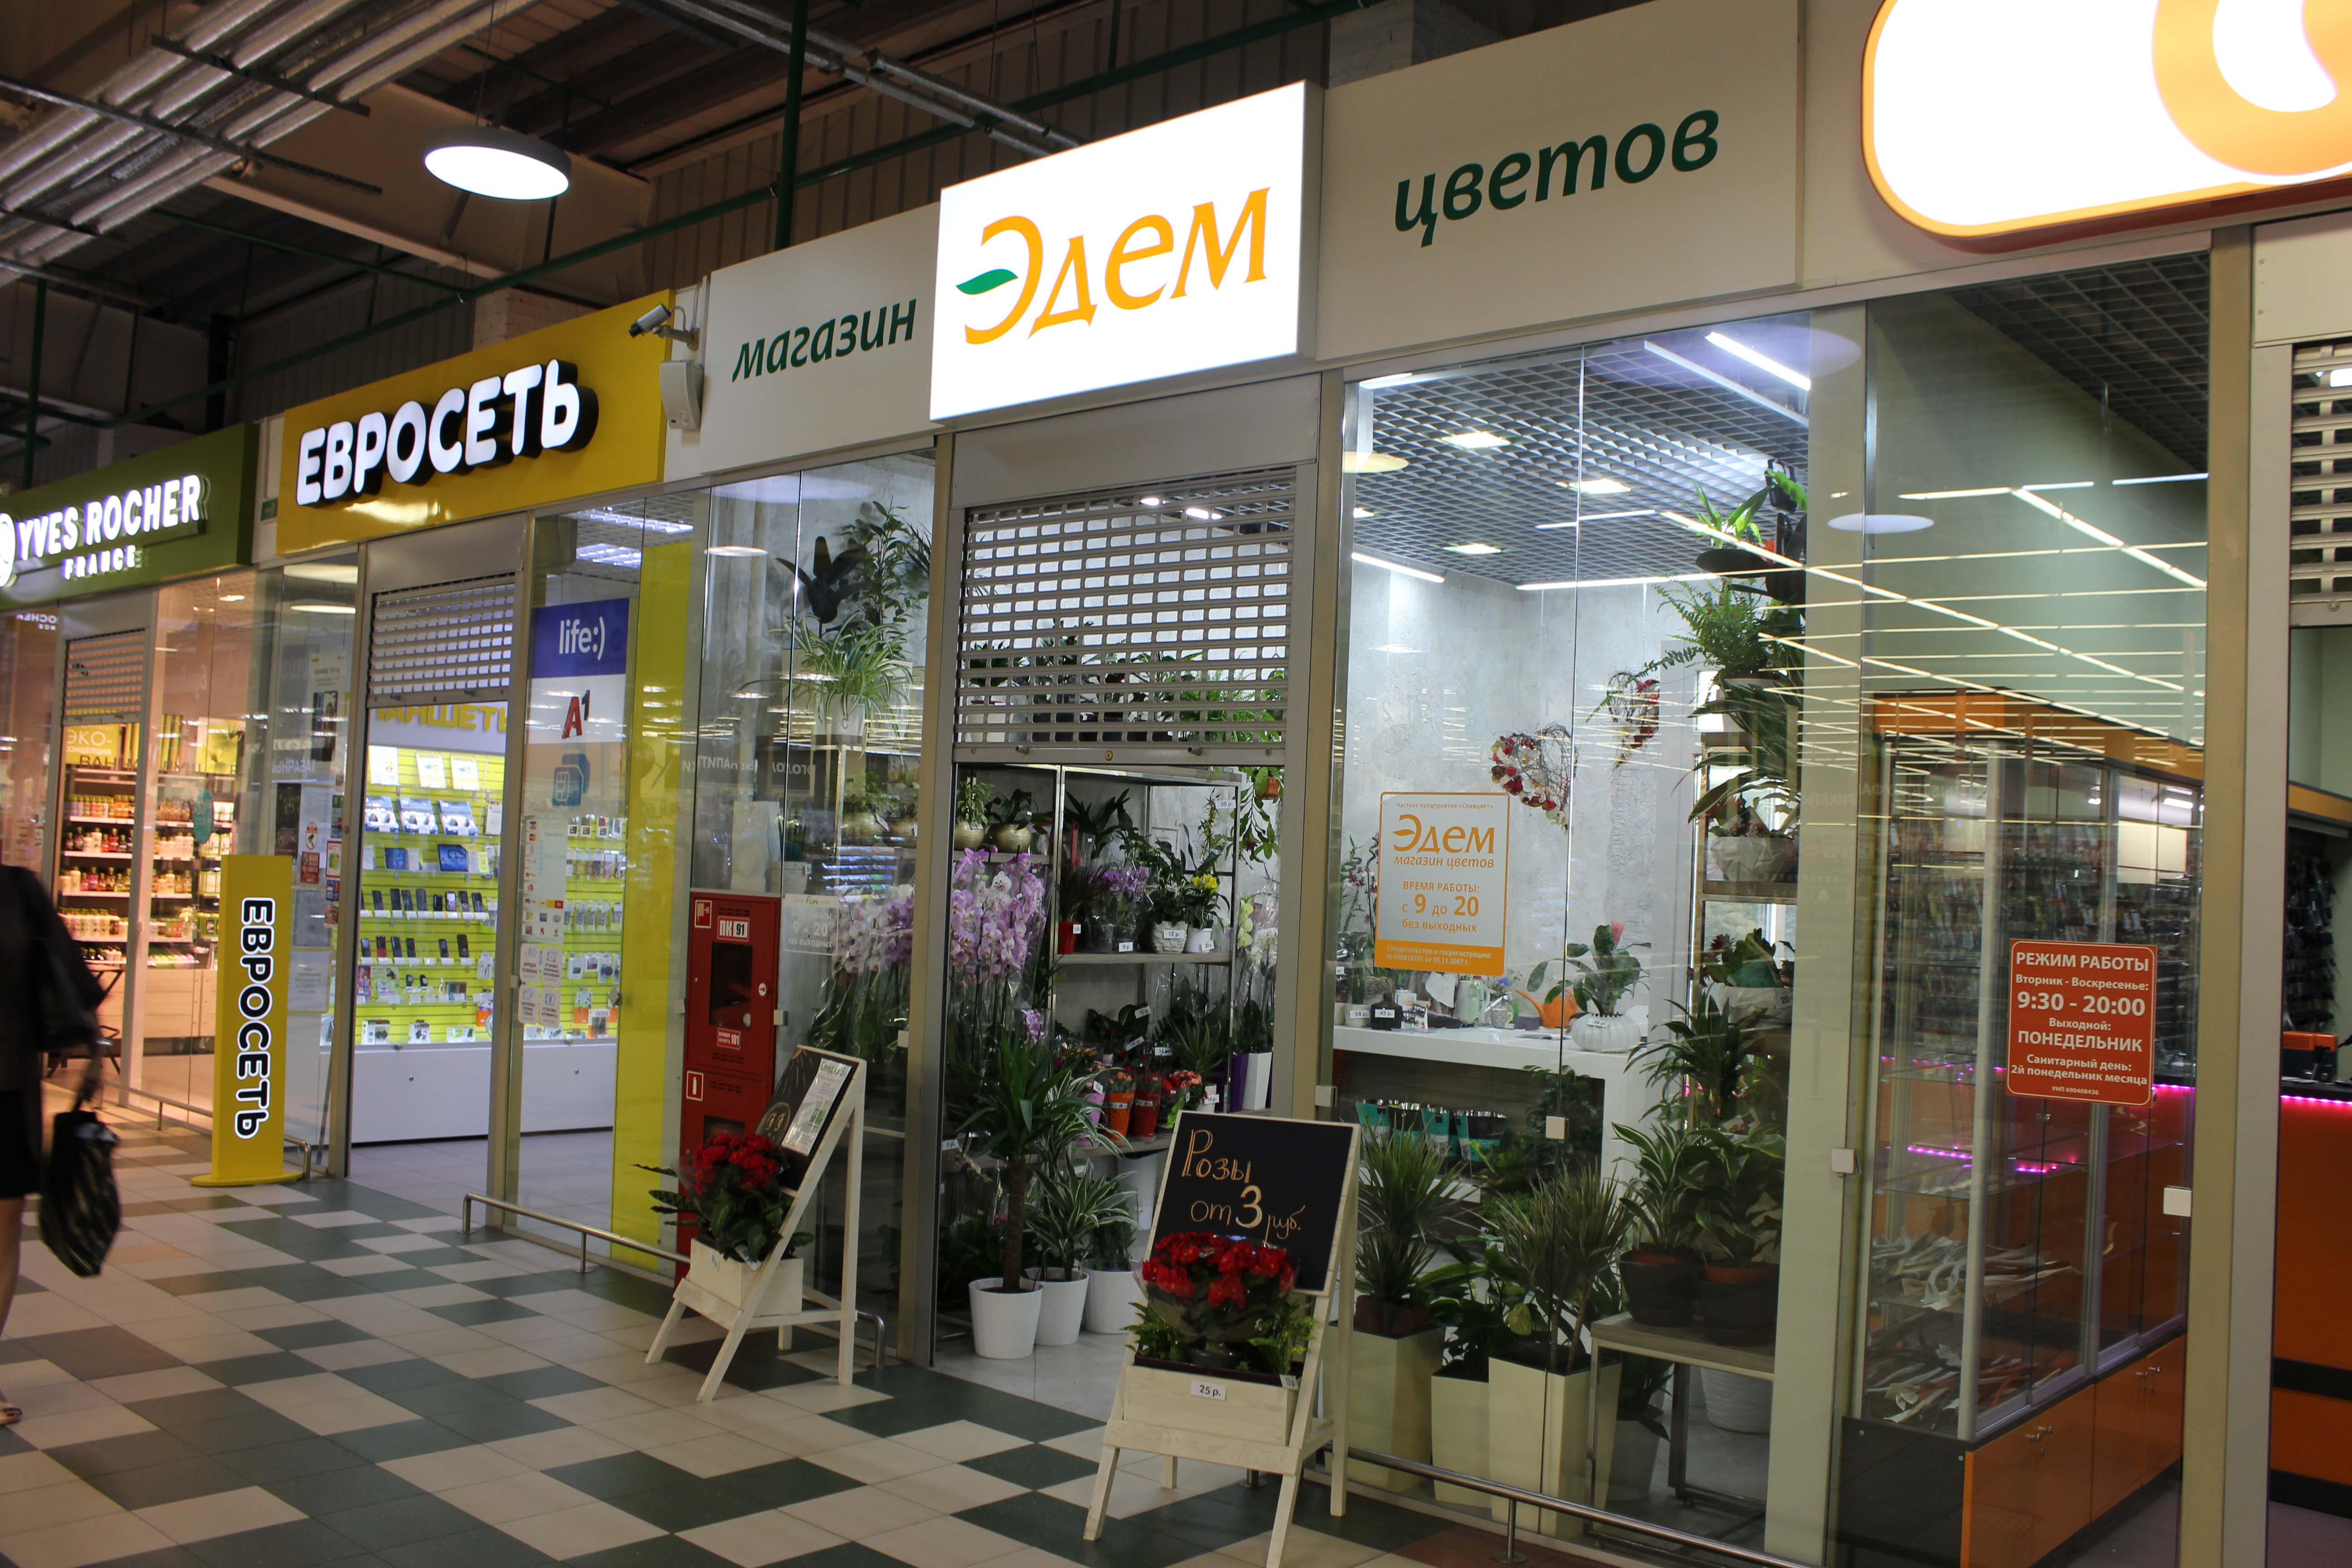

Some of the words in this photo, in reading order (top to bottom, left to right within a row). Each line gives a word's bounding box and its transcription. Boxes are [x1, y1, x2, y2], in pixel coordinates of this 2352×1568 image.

[1395, 109, 1719, 248] цветов
[955, 187, 1270, 344] Эдем
[731, 299, 916, 383] магазин
[296, 359, 581, 506] ЕВРОСЕТЬ
[16, 506, 79, 561] YVES
[85, 475, 201, 545] ROCHER
[63, 545, 136, 580] FRANCE
[559, 616, 606, 661] life:)
[1393, 814, 1495, 854] Эдем
[1394, 856, 1443, 866] магазин
[1447, 857, 1494, 870] цветов
[1403, 881, 1434, 891] ВРЕМЯ
[1437, 883, 1480, 893] РАБОТЫ:
[1415, 894, 1426, 914] 9
[1432, 905, 1447, 916] до
[1454, 896, 1479, 916] 20
[719, 920, 732, 936] ПК
[736, 923, 744, 936] 91
[794, 920, 799, 934] 9
[813, 922, 828, 936] 20
[1402, 919, 1420, 929] без
[1423, 921, 1476, 933] выходных
[799, 938, 832, 948] ВЫХОДНЫХ
[1387, 945, 1432, 955] Свидетельство
[1439, 949, 1491, 959] госрегистрации:
[1433, 957, 1463, 965] 15.11.2007
[2016, 952, 2076, 967] РЕЖИМ
[2081, 955, 2149, 971] РАБОТЫ
[2016, 974, 2063, 986] Вторник
[2072, 977, 2149, 990] Воскресенье:
[1780, 995, 1790, 1004] 20
[2017, 991, 2064, 1010] 9:30
[2083, 996, 2145, 1016] 20:00
[234, 897, 276, 1140] ЕВРОСЕТЬ
[2049, 1018, 2111, 1030] Выходной:
[2018, 1030, 2143, 1052] ПОНЕДЕЛЬНИК
[2027, 1054, 2098, 1068] Санитарный
[2100, 1062, 2132, 1071] день:
[2011, 1065, 2024, 1074] 2й
[2027, 1068, 2102, 1081] понедельник
[2105, 1075, 2147, 1085] месяца
[1181, 1129, 1251, 1183] Розы
[1191, 1200, 1231, 1225] от
[1235, 1185, 1262, 1228] 3
[1265, 1205, 1306, 1244] руб.
[1199, 1384, 1210, 1394] 25
